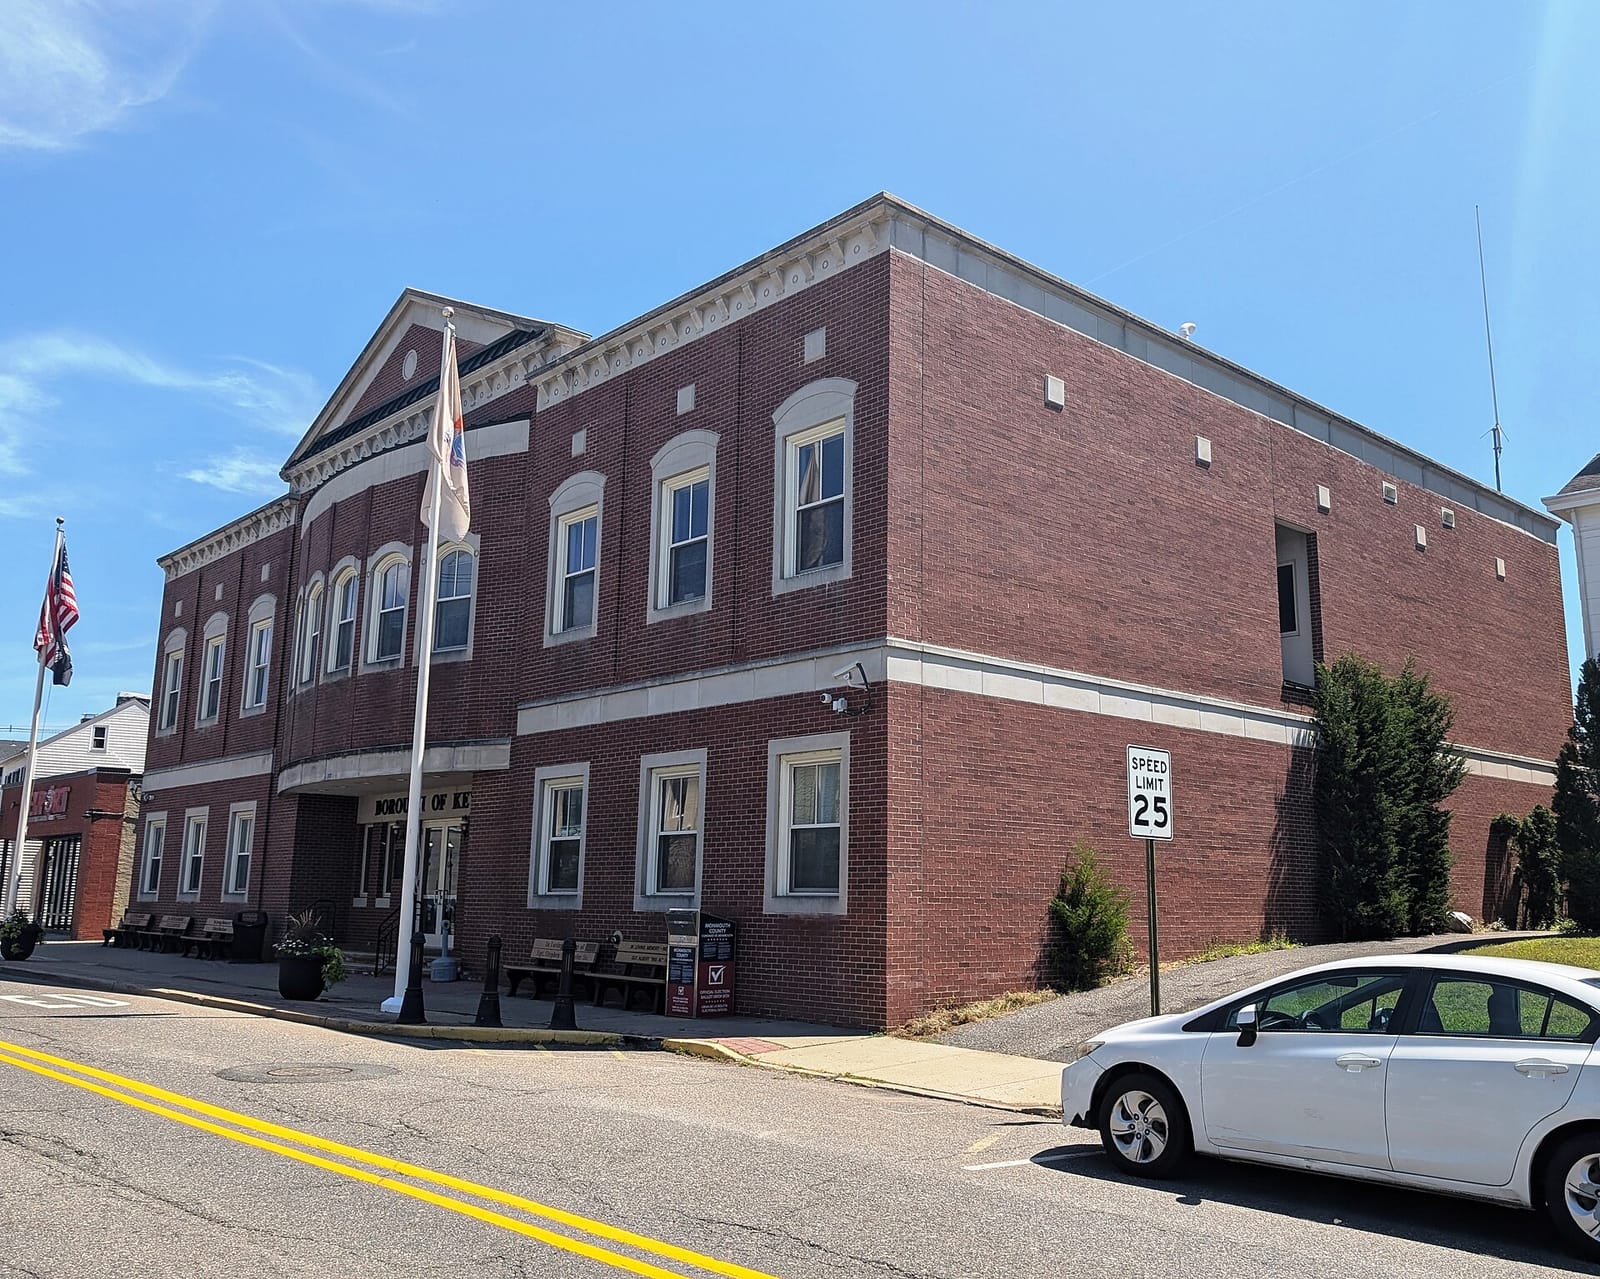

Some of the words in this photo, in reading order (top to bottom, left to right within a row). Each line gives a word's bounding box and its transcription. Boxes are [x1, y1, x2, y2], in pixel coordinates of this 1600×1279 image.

[1132, 757, 1167, 774] SPEED
[1136, 775, 1164, 791] LIMIT
[374, 795, 426, 816] BOROU
[431, 793, 447, 811] OF
[452, 791, 473, 809] KE
[1134, 794, 1168, 828] 25
